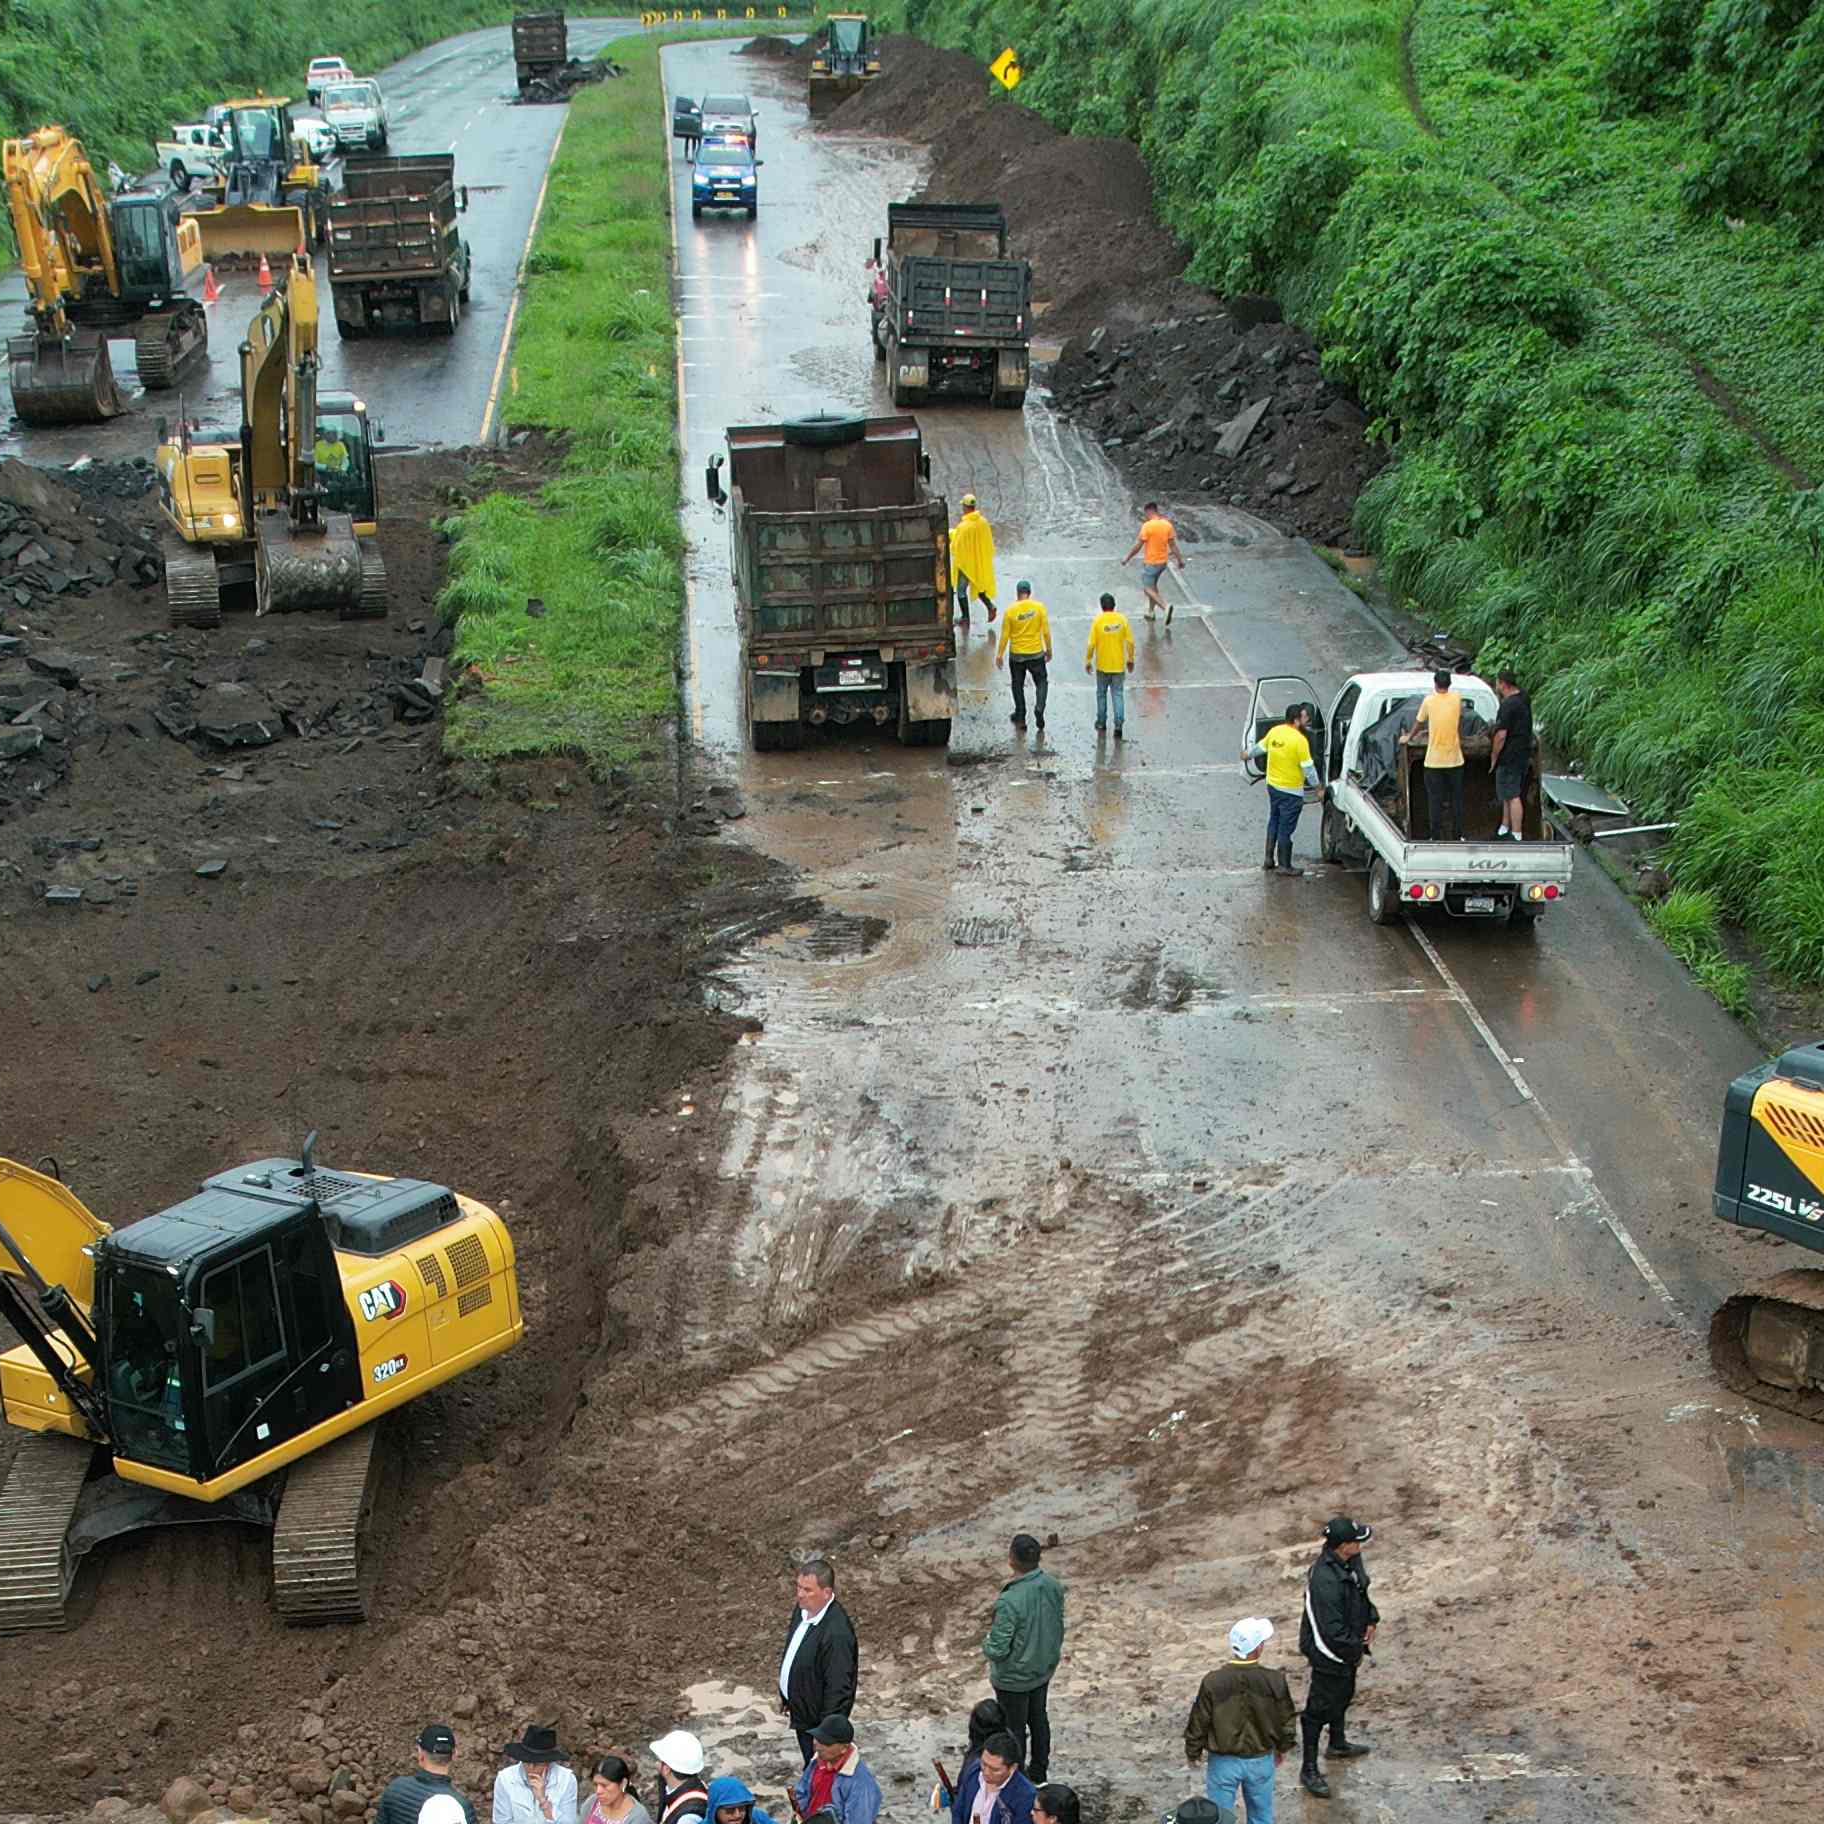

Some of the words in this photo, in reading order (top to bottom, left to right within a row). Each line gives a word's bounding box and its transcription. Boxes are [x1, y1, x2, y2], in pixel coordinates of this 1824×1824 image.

[899, 365, 926, 383] CAT
[1747, 1183, 1796, 1215] 225L
[359, 1282, 396, 1321] CAT
